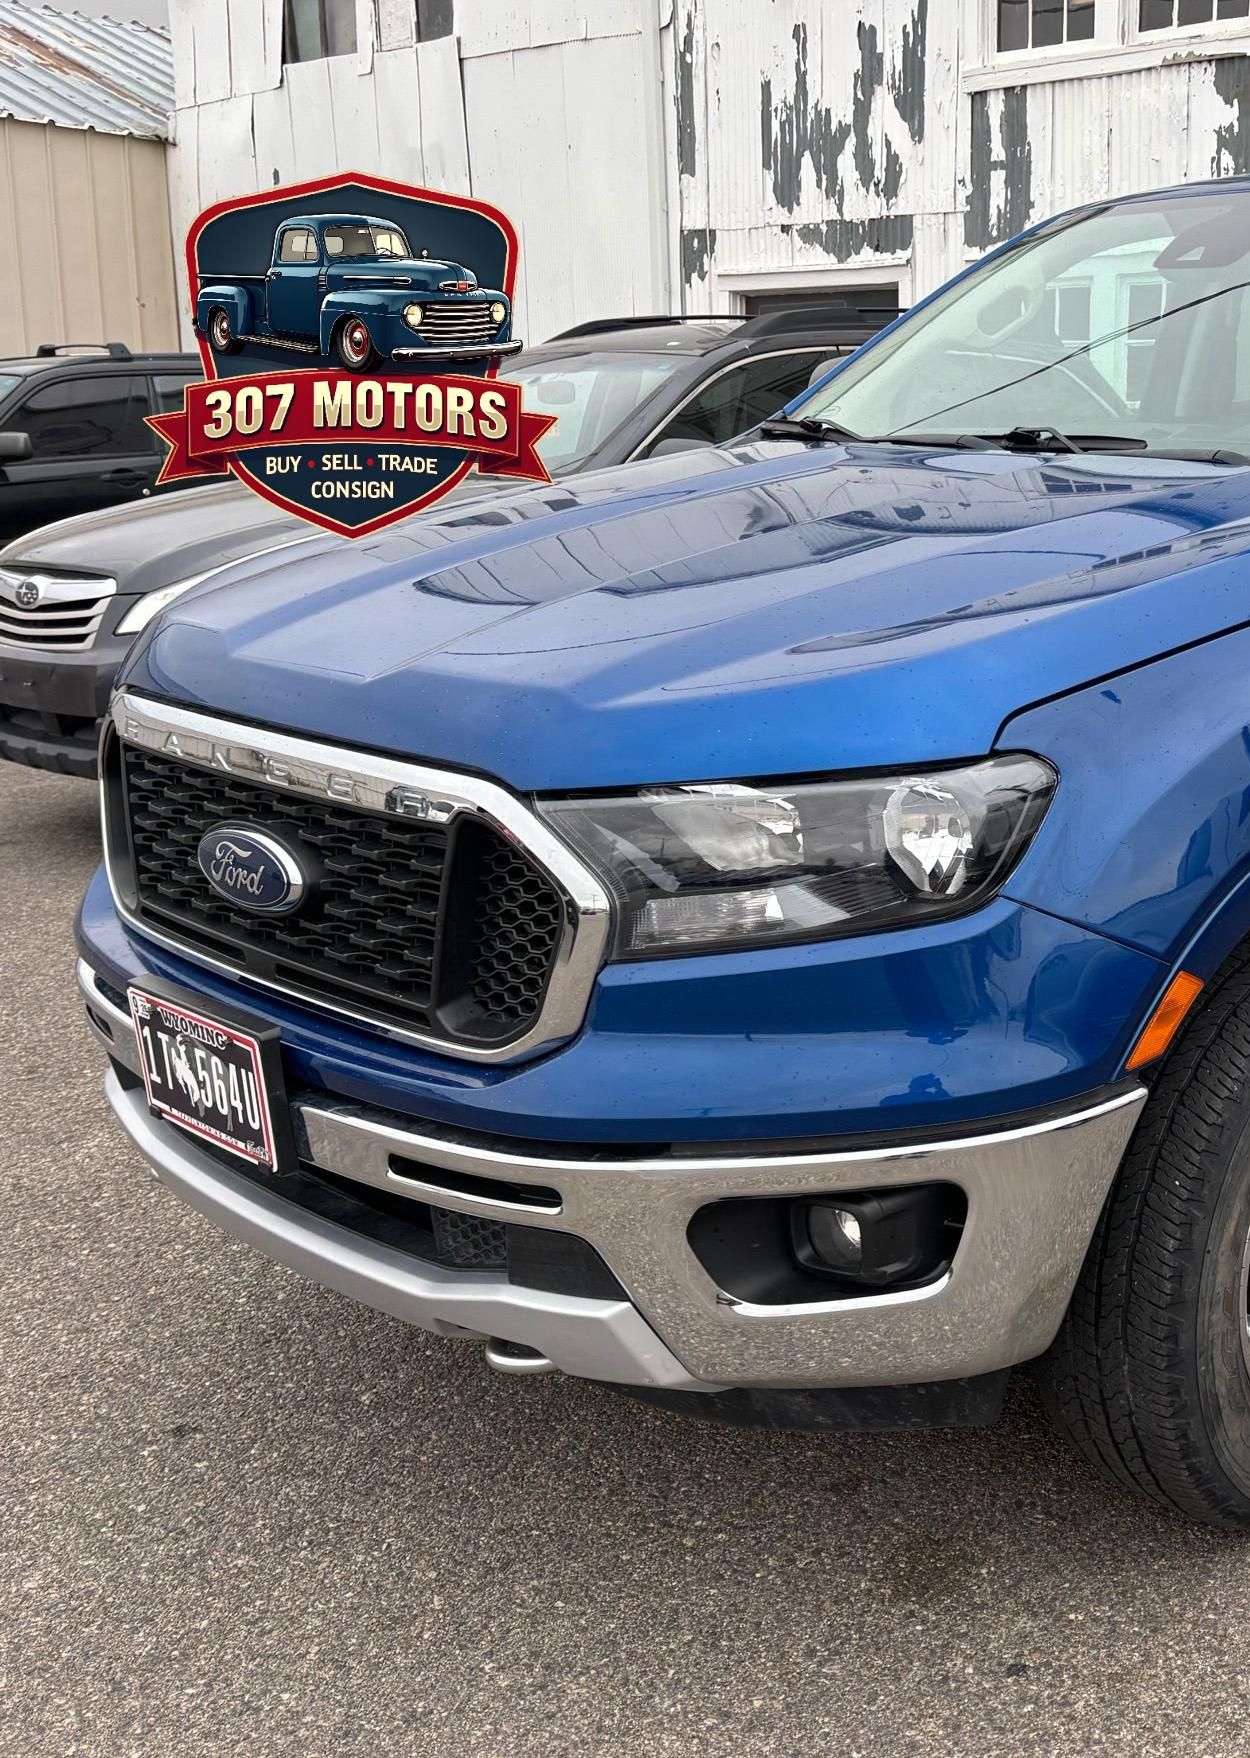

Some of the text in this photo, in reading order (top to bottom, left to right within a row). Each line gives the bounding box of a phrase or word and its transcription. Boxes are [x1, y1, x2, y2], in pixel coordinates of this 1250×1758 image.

[124, 715, 429, 818] RANGER
[211, 841, 265, 895] Ford
[160, 1007, 226, 1050] WYOMING
